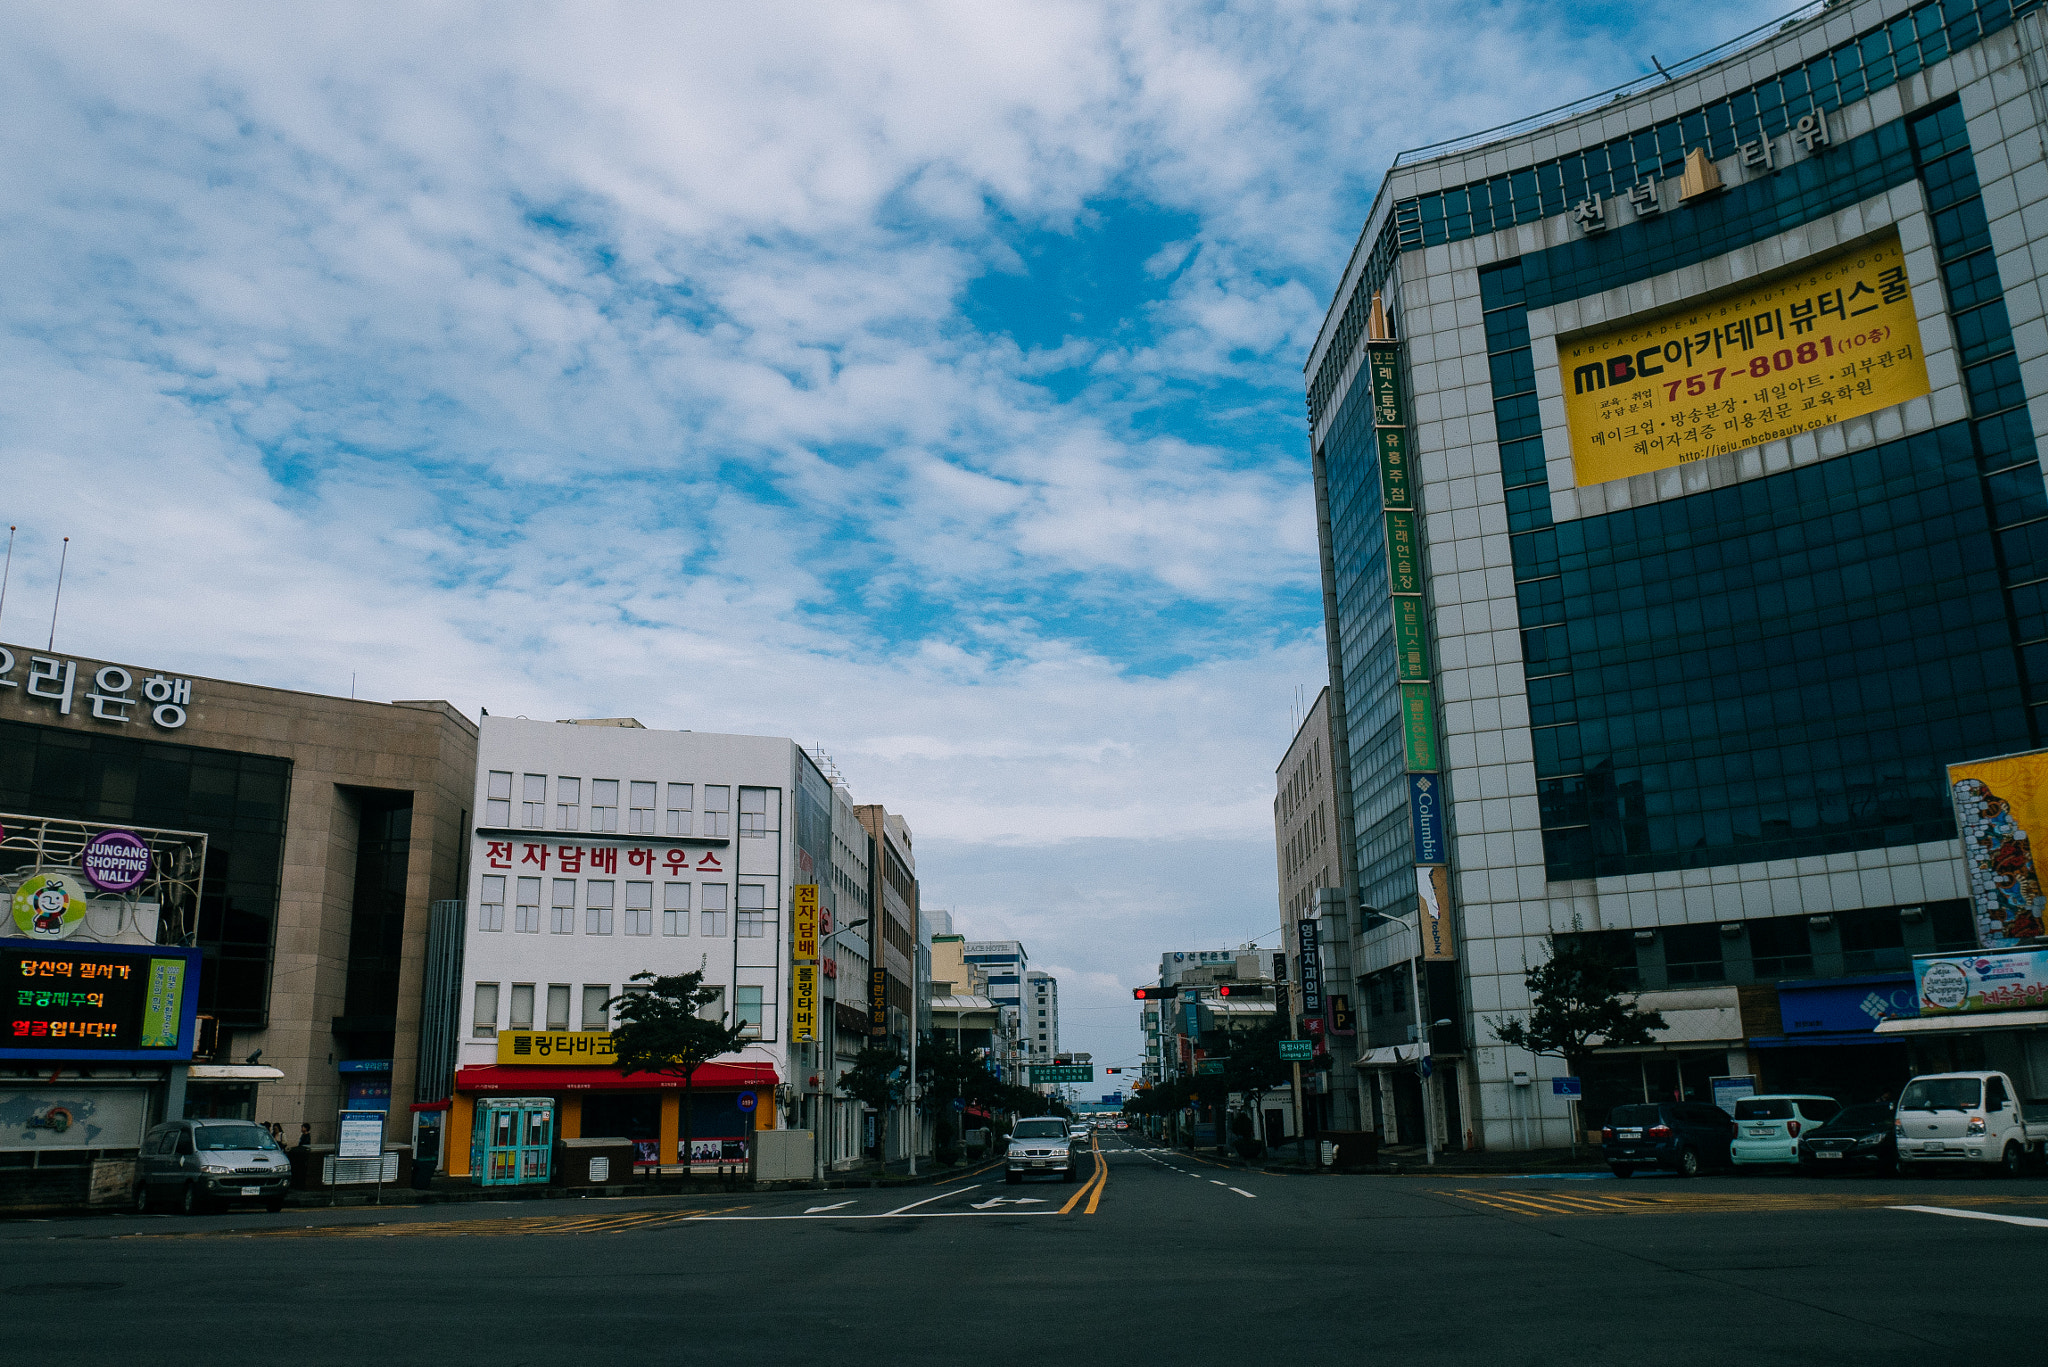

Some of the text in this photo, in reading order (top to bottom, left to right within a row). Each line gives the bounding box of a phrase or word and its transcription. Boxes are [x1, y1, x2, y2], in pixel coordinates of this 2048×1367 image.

[1379, 367, 1397, 422] 레스토랑
[1591, 344, 1913, 446] 메이크업 방송분장 네일아트 피부관리
[1634, 424, 1716, 455] 헤어자격증
[1801, 378, 1873, 411] 교육학원
[1679, 414, 1838, 462] http://jeju.mbcbeauty.co.kr
[1386, 434, 1405, 502] 유흥주점
[1394, 515, 1413, 589] 노래연습장
[1418, 792, 1437, 861] Columbia
[85, 855, 147, 872] SHOPPING
[87, 842, 149, 859] JUNGANG
[486, 841, 723, 877] 전자담배하우스
[98, 869, 132, 883] MALL
[798, 887, 816, 956] 전자담배
[20, 959, 132, 980] 당신의 질서가
[1301, 924, 1319, 1010] 영도치과의원
[17, 989, 105, 1008] 관광제주의
[1979, 981, 2048, 1007] 제주중앙
[11, 1019, 118, 1038] 얼굴입니다!!
[1337, 1013, 1346, 1028] P
